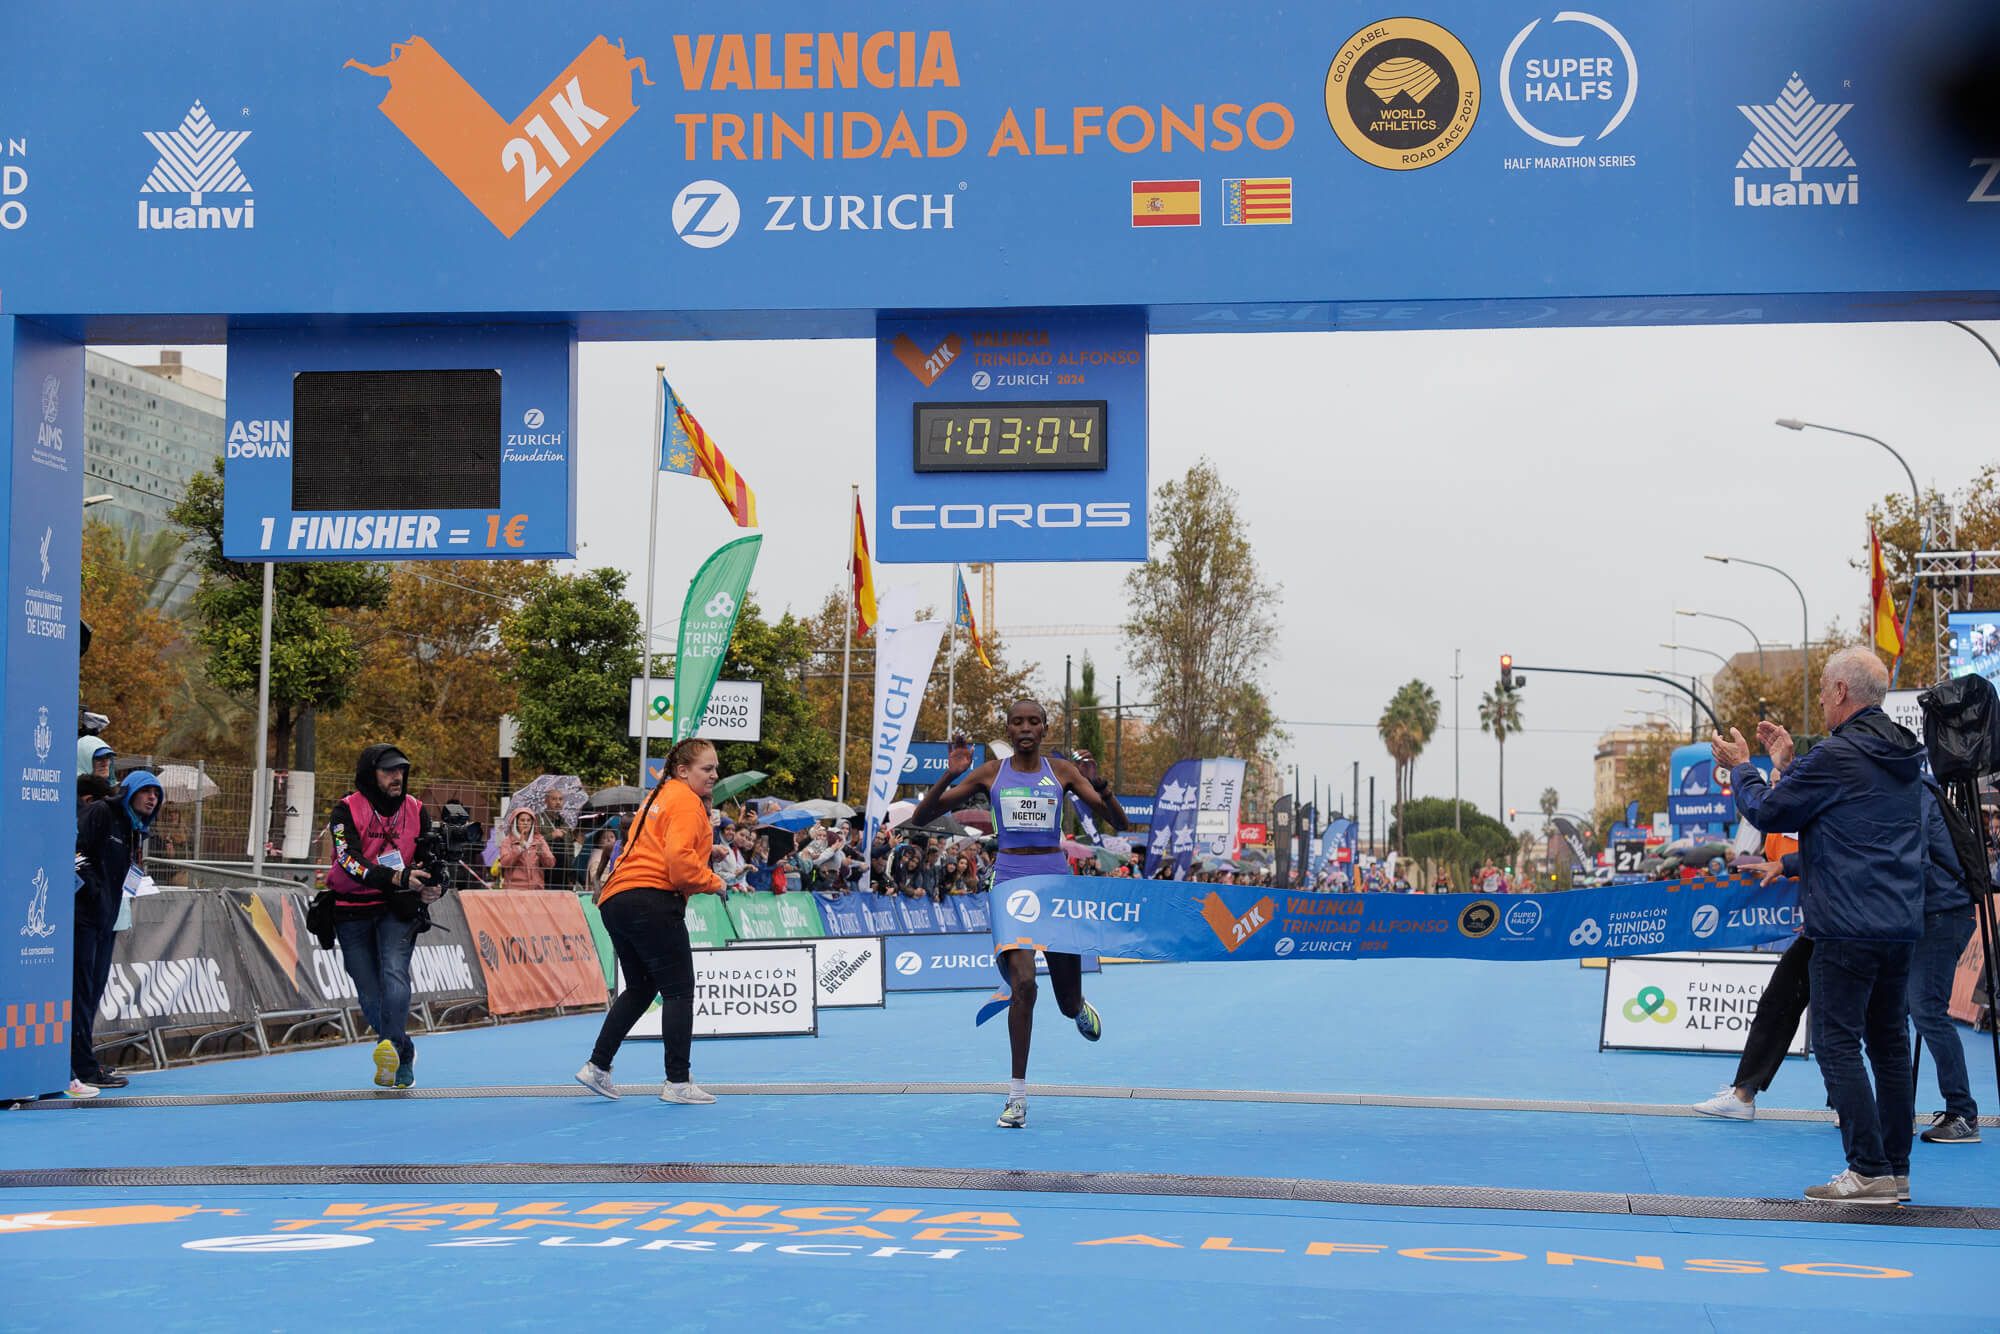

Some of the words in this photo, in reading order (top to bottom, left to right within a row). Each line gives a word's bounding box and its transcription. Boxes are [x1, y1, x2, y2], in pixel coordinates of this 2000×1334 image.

[673, 31, 960, 90] VALENCIA
[1334, 51, 1354, 83] GOLD
[1353, 27, 1390, 52] LABEL
[1526, 58, 1613, 78] SUPER
[1526, 81, 1612, 102] HALFS
[1380, 109, 1426, 119] WORLD
[674, 110, 967, 160] TRINIDAD
[987, 102, 1294, 157] ALFONSO
[1370, 120, 1436, 131] ATHLETICS
[1402, 148, 1436, 164] ROAD
[1436, 124, 1464, 152] RACE
[1459, 90, 1474, 122] 2024
[0, 138, 26, 156] N
[501, 76, 610, 202] 21K
[1504, 158, 1532, 170] HALF
[1535, 156, 1596, 168] MARATHON
[1599, 156, 1636, 167] SERIES
[1734, 175, 1858, 206] luanvi
[138, 200, 254, 229] luanvi
[765, 194, 954, 231] ZURICH
[972, 330, 1048, 347] VALENCIA
[924, 344, 954, 377] 21K
[974, 352, 1052, 366] TRINIDAD
[1058, 351, 1140, 366] ALFONSO
[997, 374, 1048, 386] ZURICH
[1057, 374, 1085, 384] 2024
[228, 420, 290, 442] ASIN
[507, 433, 562, 446] ZURICH
[945, 418, 1092, 454] 1:03:04
[228, 442, 290, 458] DOWN
[502, 449, 564, 463] Foundation
[892, 503, 1130, 530] COROS
[259, 518, 276, 550] 1
[288, 515, 440, 550] FINISHER
[486, 514, 528, 548] 1€
[26, 600, 62, 621] COMUNITAT
[874, 674, 913, 800] ZURICH
[1020, 800, 1037, 808] 201
[1676, 802, 1712, 816] luanvi
[1012, 812, 1046, 821] NGETICH
[1617, 852, 1642, 871] 21
[1051, 898, 1141, 922] ZURICH
[1286, 898, 1364, 916] VALENCIA
[1610, 908, 1668, 920] FUNDACIÓN
[1726, 906, 1804, 928] ZURICH
[1232, 906, 1264, 944] 21K
[1282, 919, 1361, 934] TRINIDAD
[1366, 919, 1448, 933] ALFONSO
[1607, 918, 1666, 934] TRINIDAD
[1300, 942, 1352, 952] ZURICH
[1604, 932, 1664, 948] ALFONSO
[696, 968, 797, 980] FUNDACIÓN
[820, 960, 848, 988] CIUDAD
[826, 980, 842, 994] DEL
[838, 950, 872, 982] RUNNING
[130, 958, 230, 1016] RUNNING
[696, 983, 798, 998] TRINIDAD
[696, 999, 798, 1016] ALFONSO
[322, 1201, 1021, 1228] VALENCIA
[271, 1218, 1025, 1242] TRINIDAD
[1078, 1234, 1913, 1278] ALFONSO
[427, 1236, 983, 1260] ZURICH
